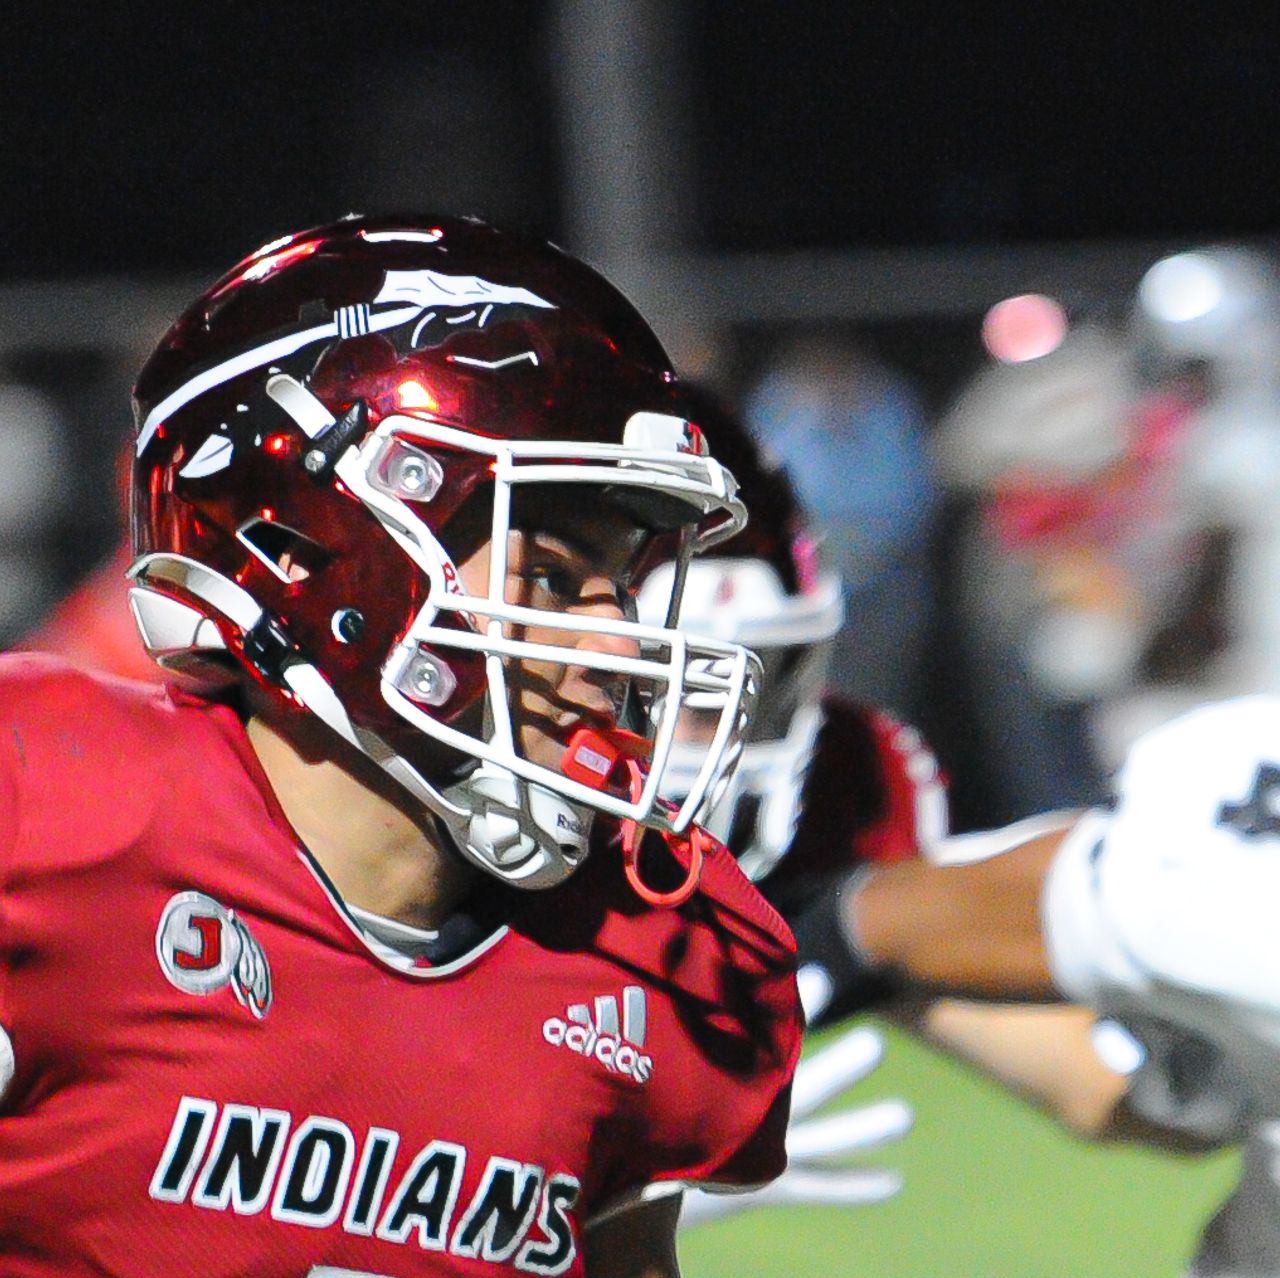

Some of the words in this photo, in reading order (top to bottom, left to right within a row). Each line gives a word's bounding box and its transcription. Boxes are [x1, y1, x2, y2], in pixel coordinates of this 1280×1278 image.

[172, 914, 222, 970] J
[542, 1017, 654, 1084] adidas
[148, 1095, 581, 1277] INDIANS
